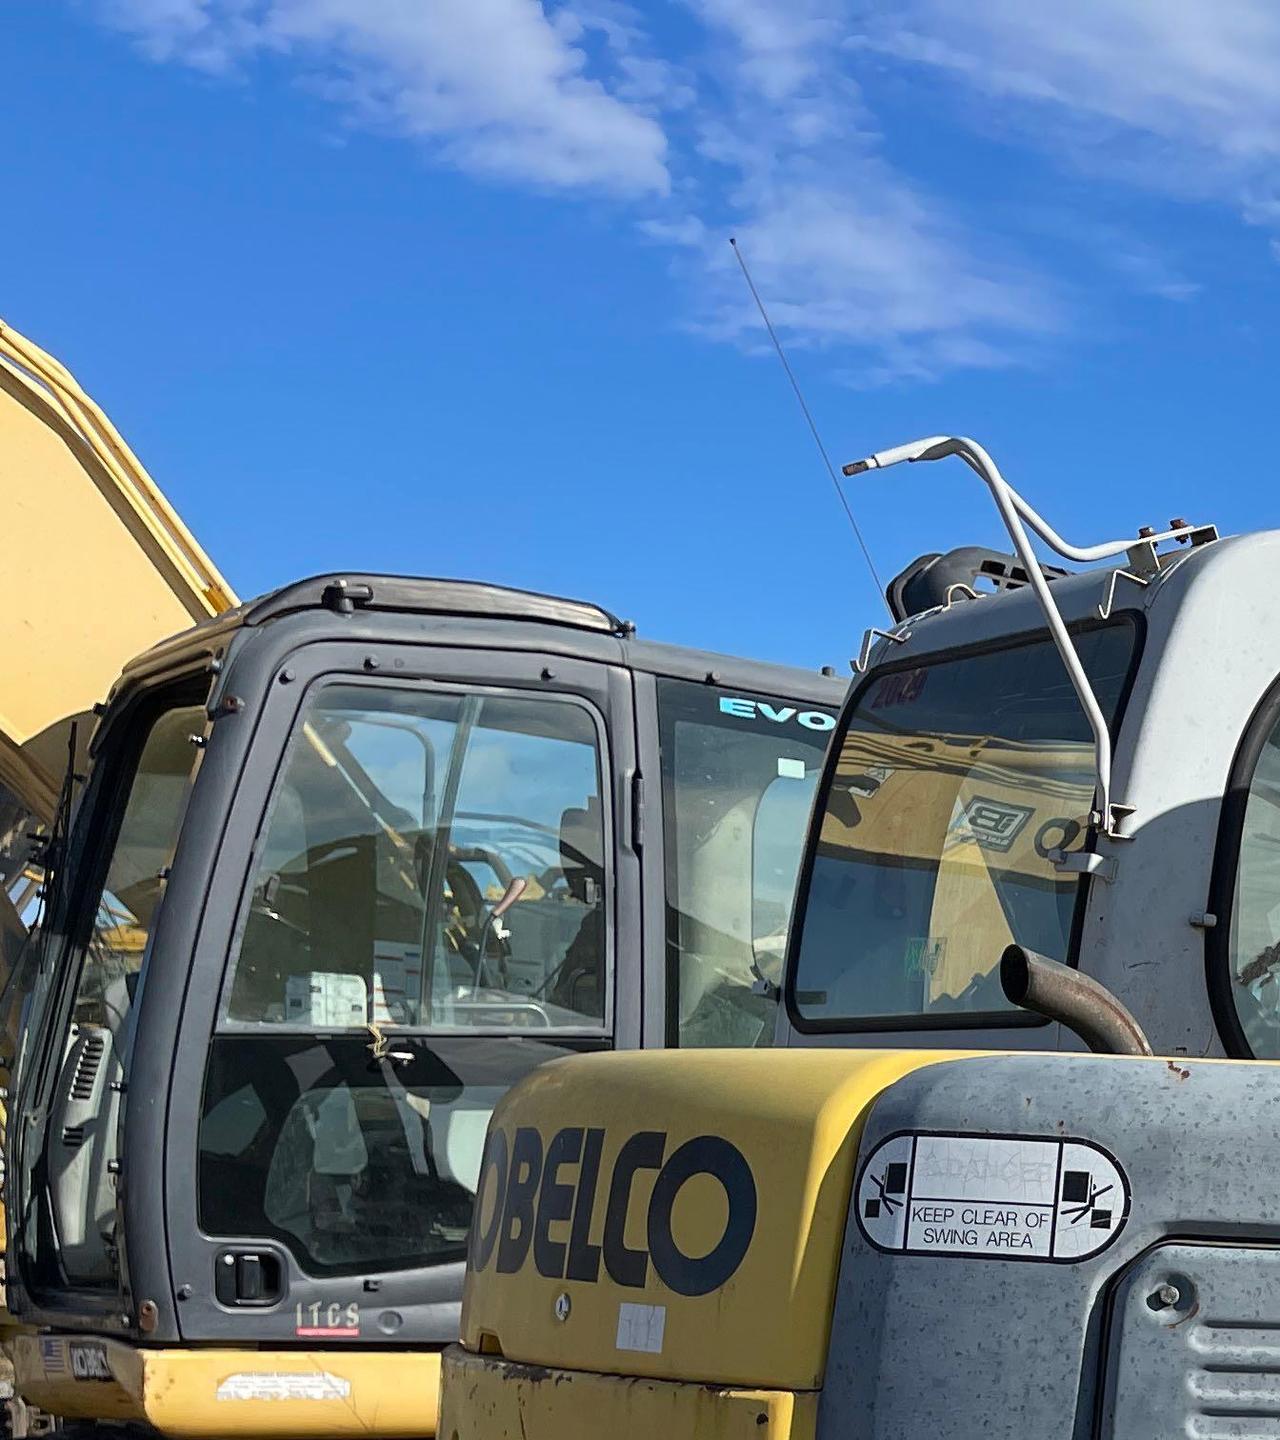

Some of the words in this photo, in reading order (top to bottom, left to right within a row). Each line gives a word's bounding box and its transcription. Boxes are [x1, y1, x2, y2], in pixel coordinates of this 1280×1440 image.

[719, 696, 837, 732] EVO
[467, 1127, 757, 1297] OBELCO
[912, 1207, 954, 1223] KEEP
[961, 1208, 1018, 1227] CLEAR
[1025, 1212, 1050, 1229] OF
[923, 1227, 977, 1246] SWING
[986, 1231, 1033, 1249] AREA
